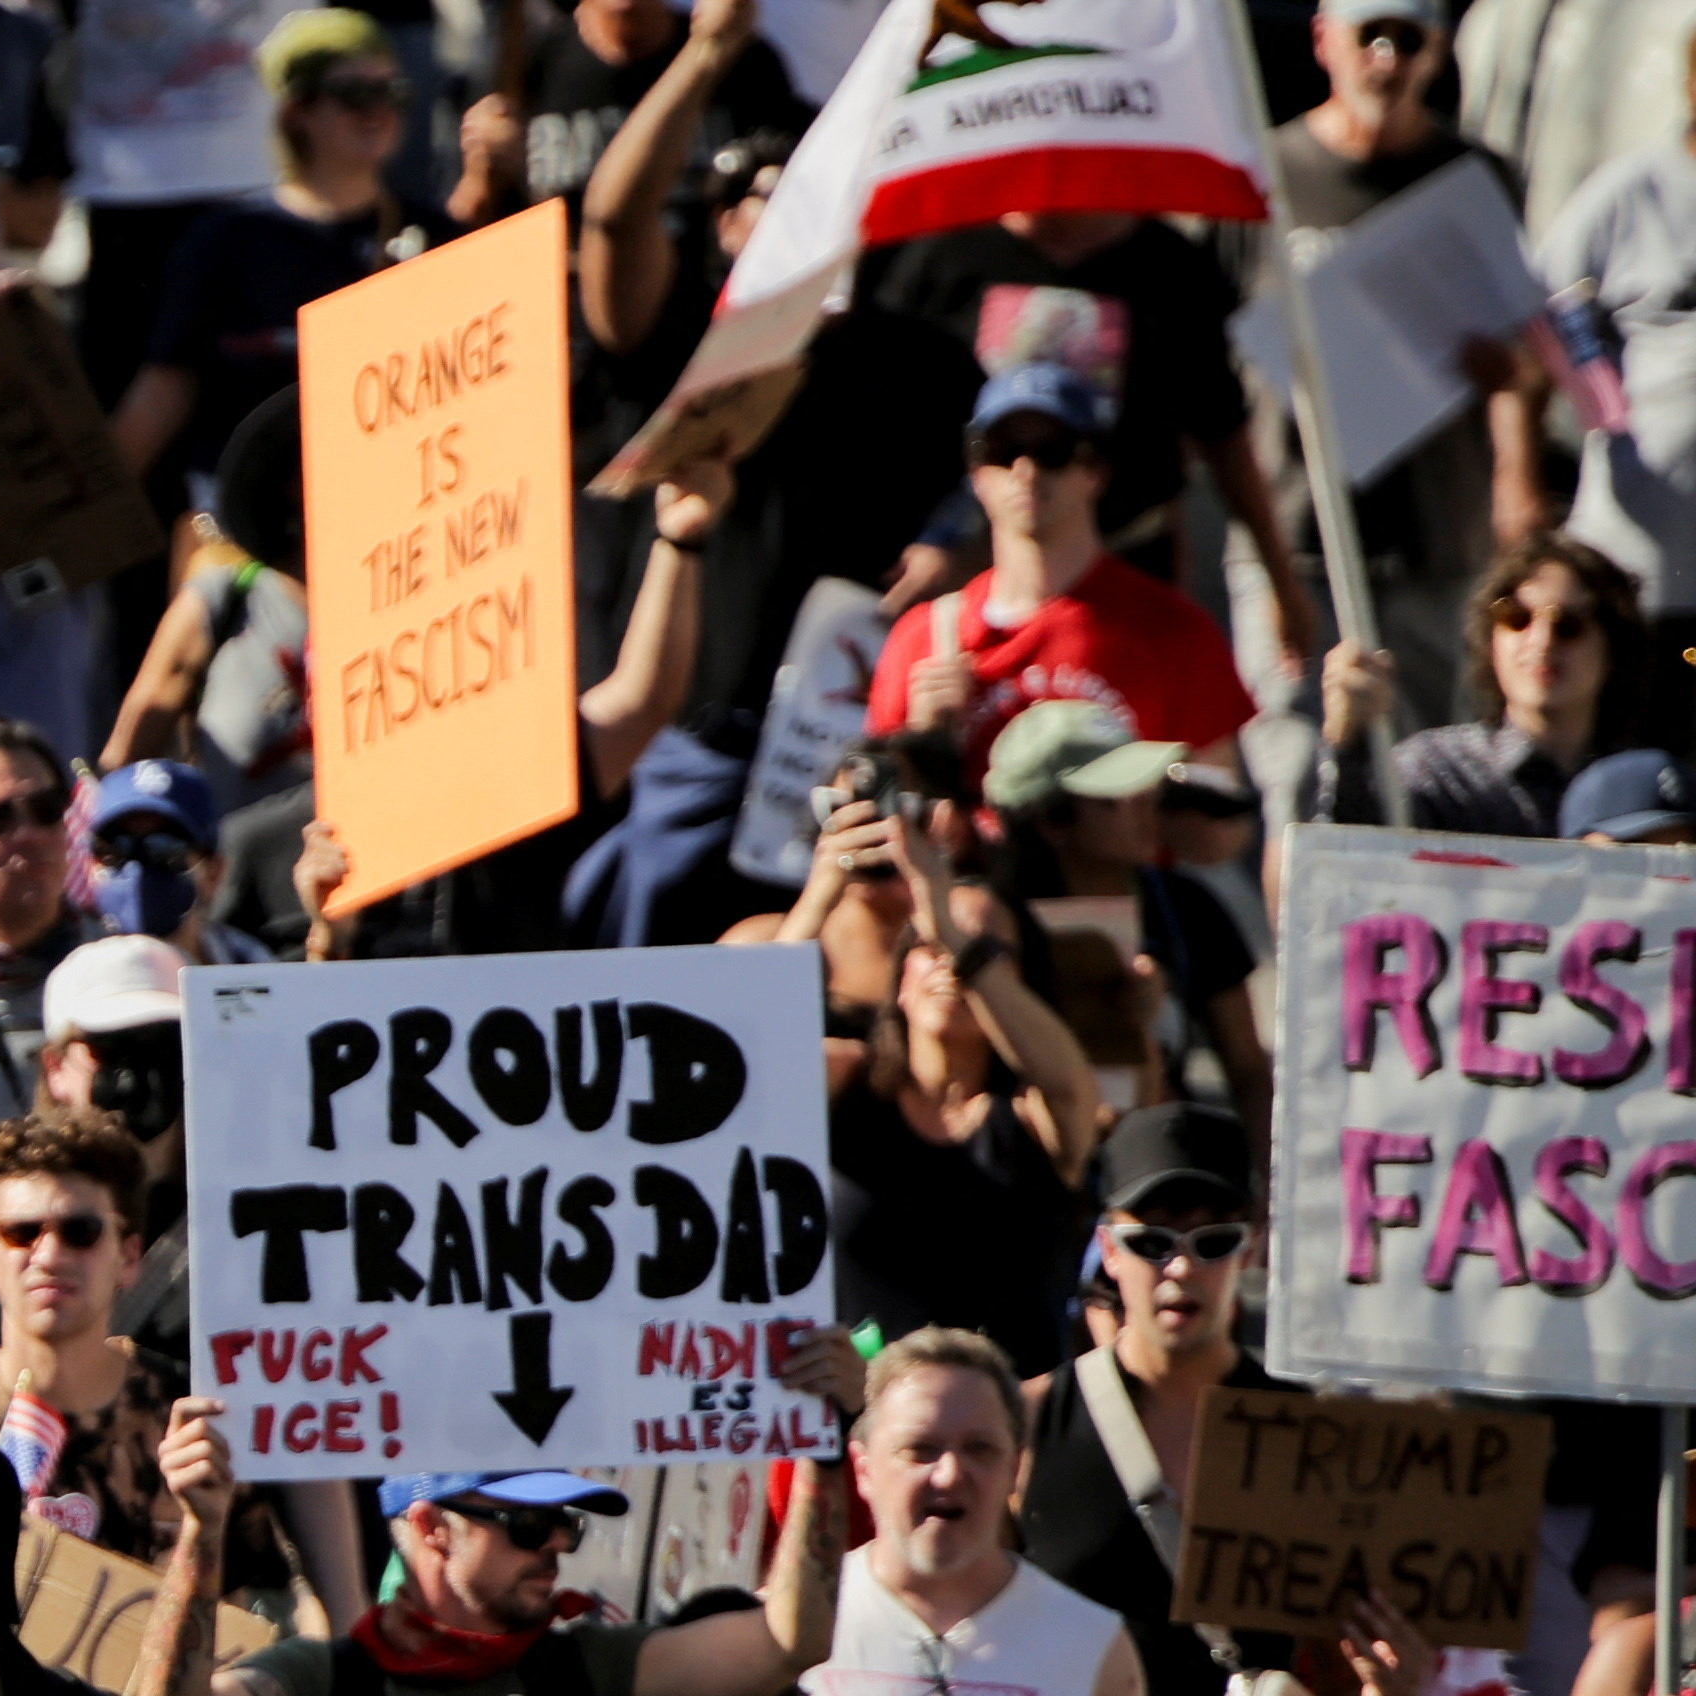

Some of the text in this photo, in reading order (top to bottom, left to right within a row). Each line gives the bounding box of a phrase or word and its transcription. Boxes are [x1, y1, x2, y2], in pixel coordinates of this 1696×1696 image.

[350, 300, 514, 435] ORANGE
[415, 423, 468, 507] IS
[360, 475, 529, 618] THE NEW
[340, 571, 538, 758] FASCISM
[307, 997, 748, 1151] PROUD
[229, 1145, 829, 1312] TRANS DAD
[207, 1322, 393, 1387] FUCK
[251, 1379, 756, 1460] ICE! ES
[632, 1405, 839, 1455] ILLEGAL!
[1223, 1398, 1514, 1500] TRUMP
[1192, 1524, 1527, 1626] TREASON
